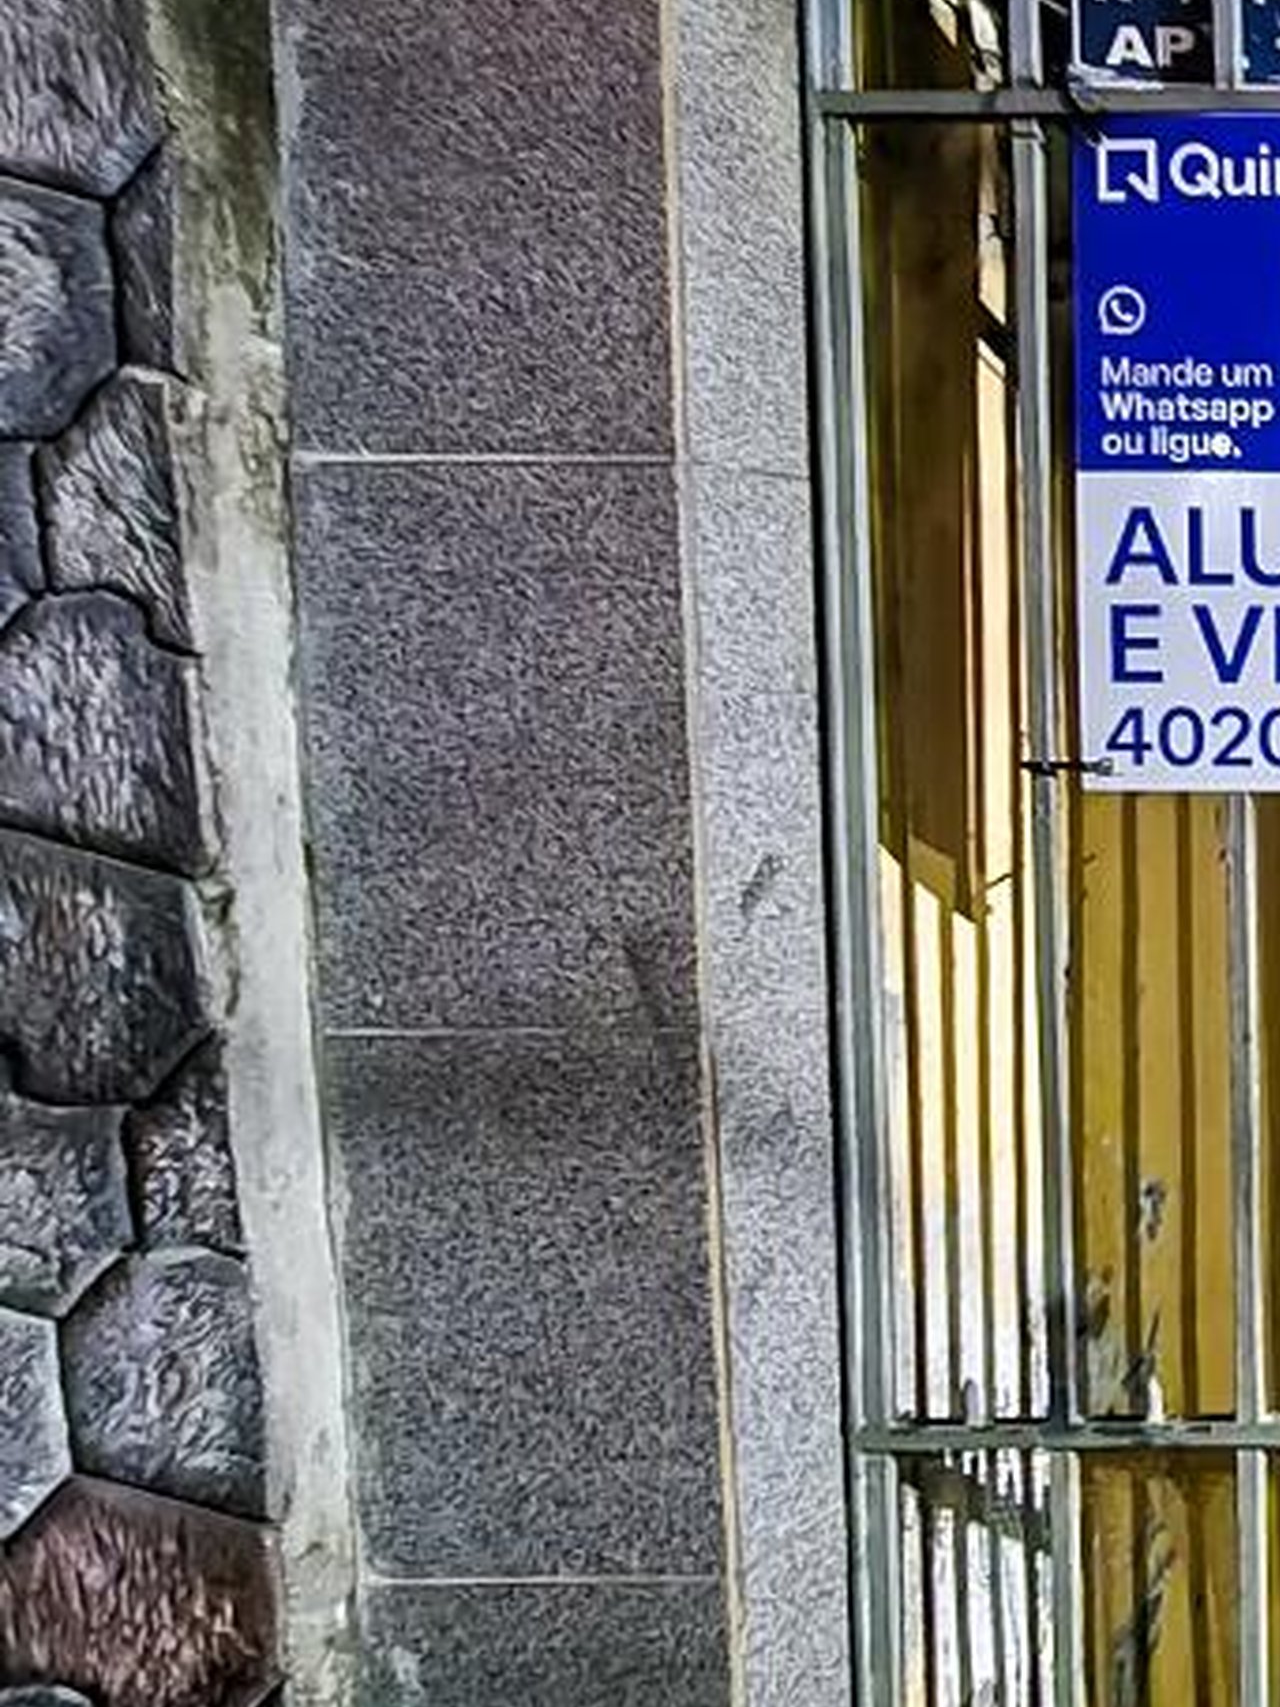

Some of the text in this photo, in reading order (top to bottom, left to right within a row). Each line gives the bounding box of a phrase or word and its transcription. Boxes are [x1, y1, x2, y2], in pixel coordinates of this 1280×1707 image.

[1107, 25, 1250, 70] AP.
[1102, 356, 1273, 388] Mande um
[1102, 393, 1275, 428] Whatsapp
[1102, 432, 1144, 457] ou
[1109, 604, 1163, 684] E
